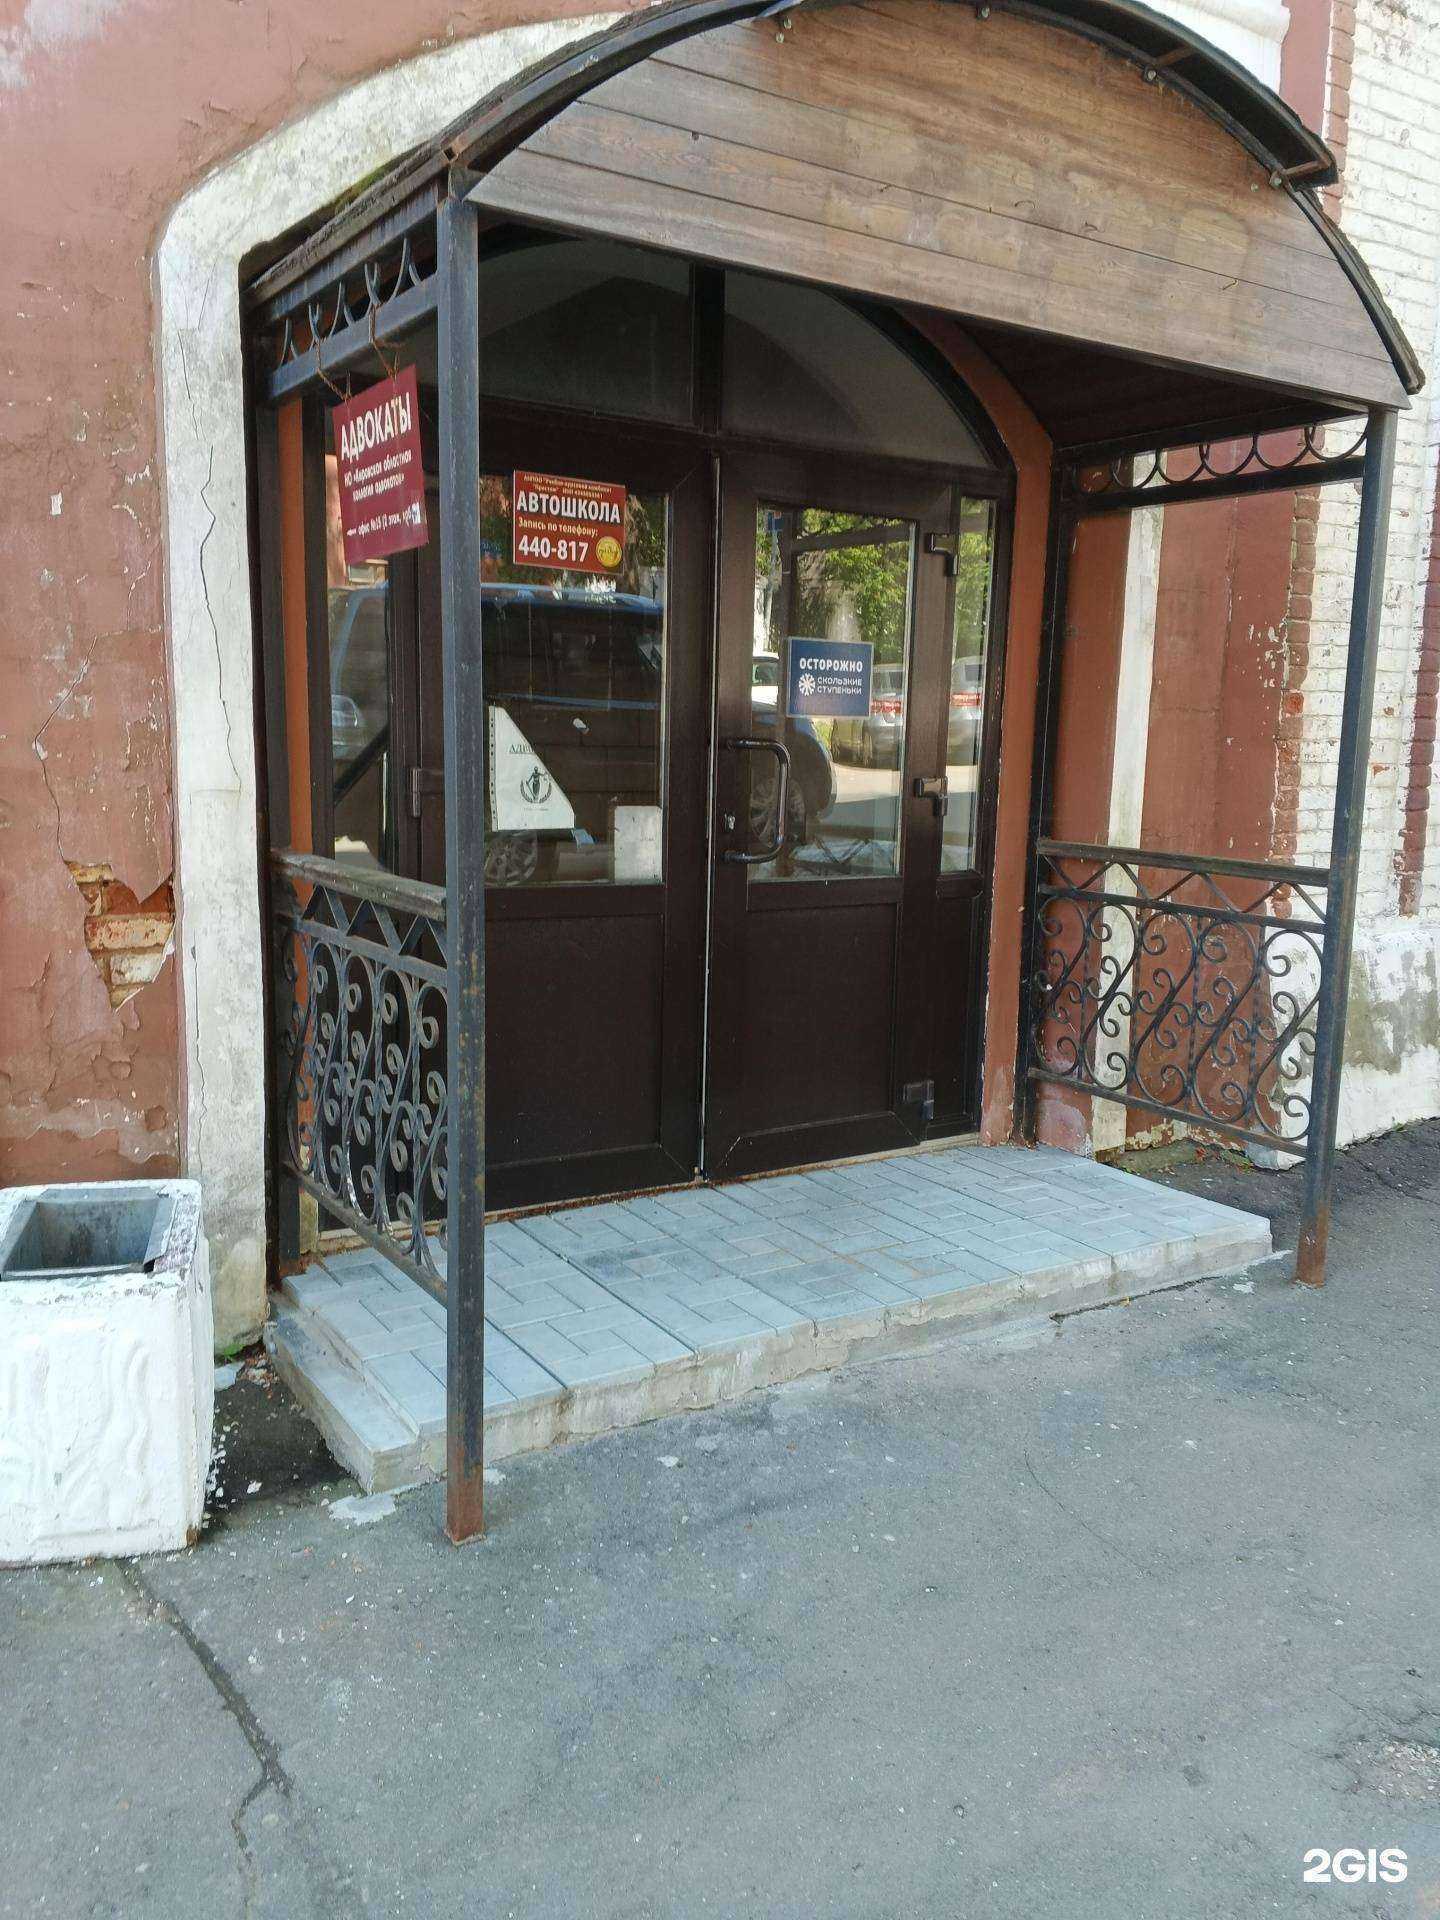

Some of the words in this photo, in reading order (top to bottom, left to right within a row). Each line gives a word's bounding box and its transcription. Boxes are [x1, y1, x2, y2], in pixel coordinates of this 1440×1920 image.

[341, 391, 412, 464] АДВОКАТЫ
[516, 490, 621, 523] АВТОШКОЛА
[518, 516, 546, 531] Запись
[547, 522, 557, 532] по
[559, 523, 599, 538] телефону:
[518, 534, 589, 563] 440-817
[799, 657, 863, 673] ОСТОРОЖНО
[817, 676, 863, 686] СКОЛЬЗКИЕ
[817, 685, 862, 695] СТУПЕНЬКИ
